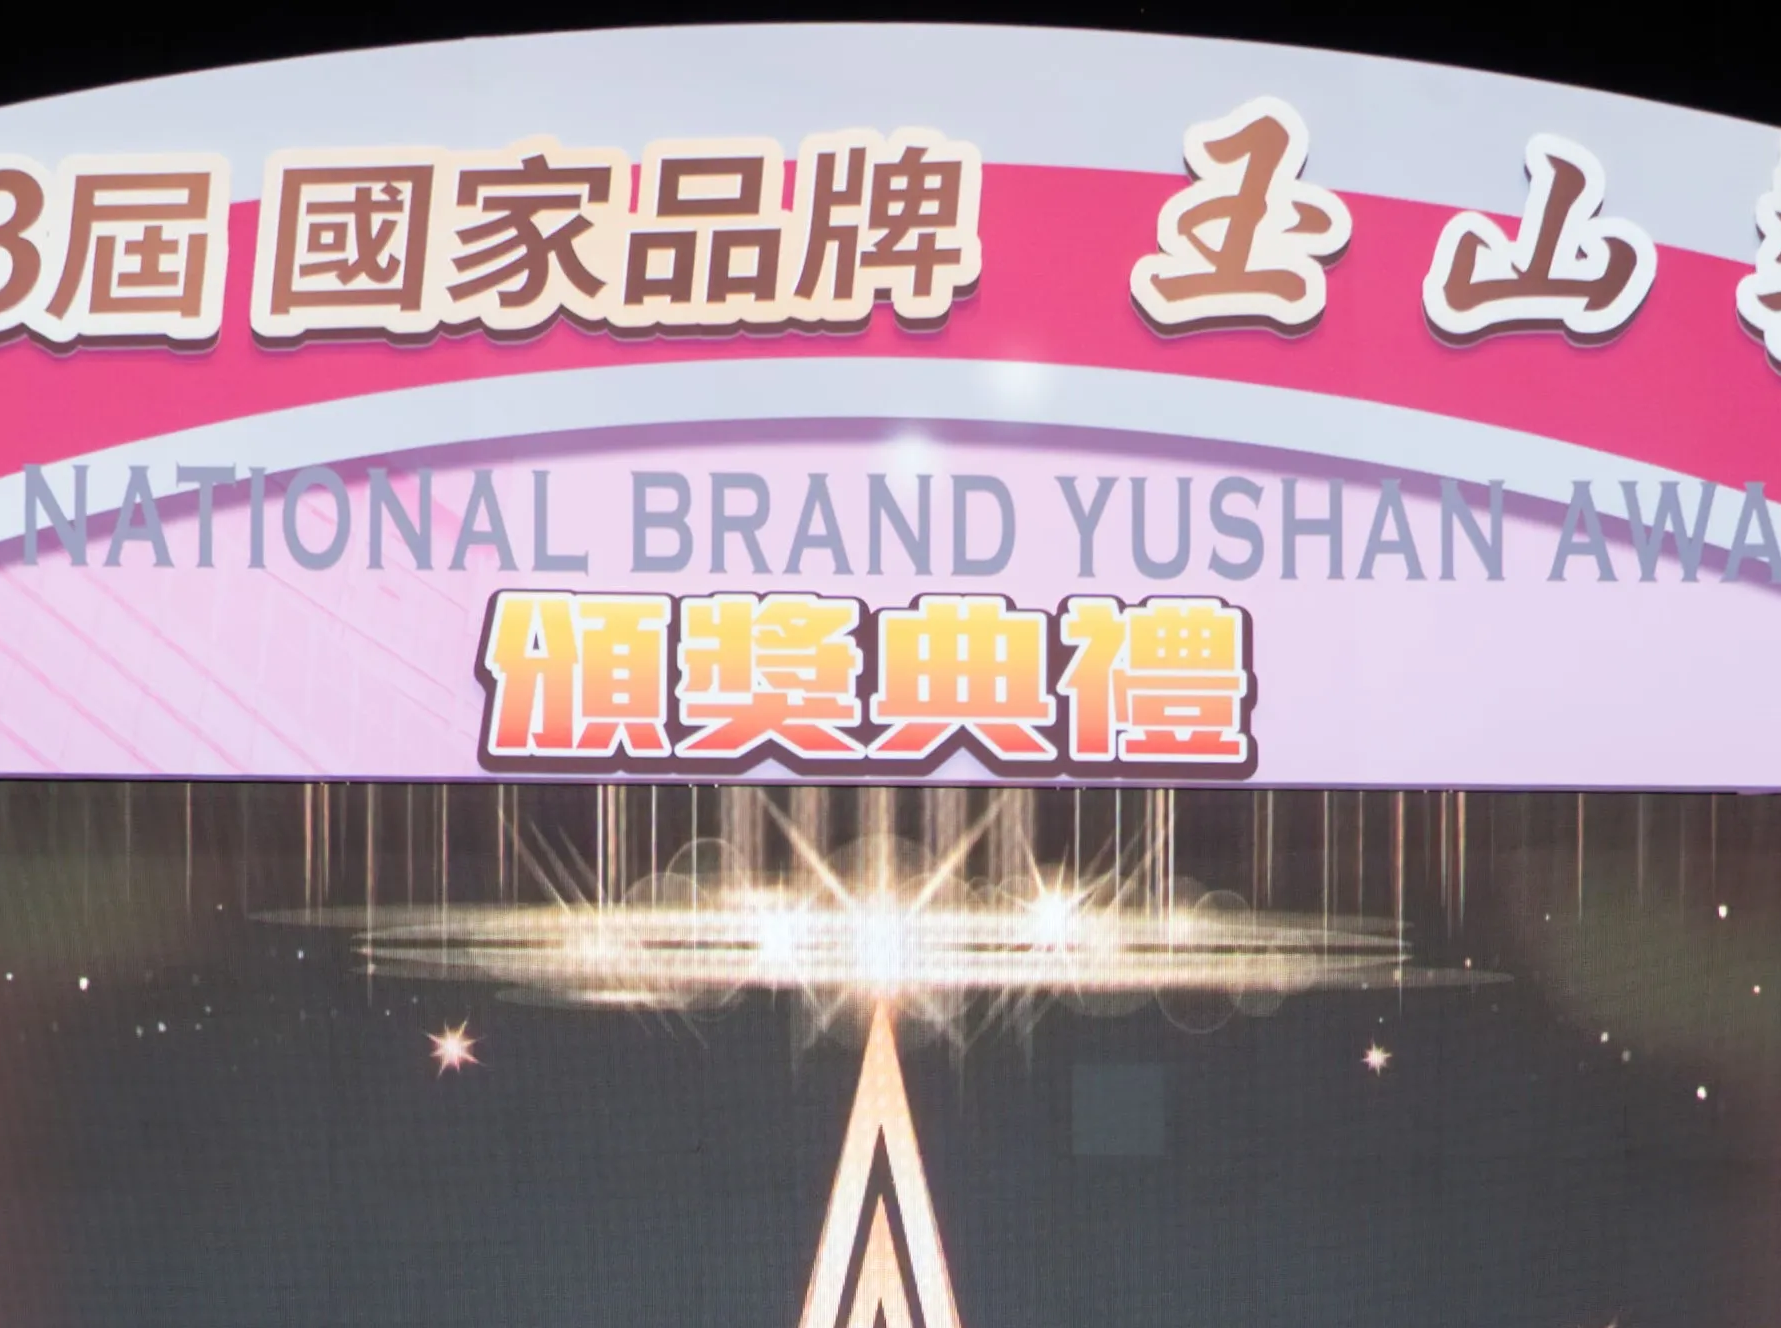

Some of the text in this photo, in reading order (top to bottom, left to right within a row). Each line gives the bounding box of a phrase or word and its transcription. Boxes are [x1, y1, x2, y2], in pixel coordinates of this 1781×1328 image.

[269, 145, 964, 317] 國家品牌
[22, 462, 591, 576] NATIONAL
[629, 469, 1017, 577] BRAND
[1054, 474, 1507, 581] YUSHAN
[487, 593, 1251, 762] 頒獎典禮
